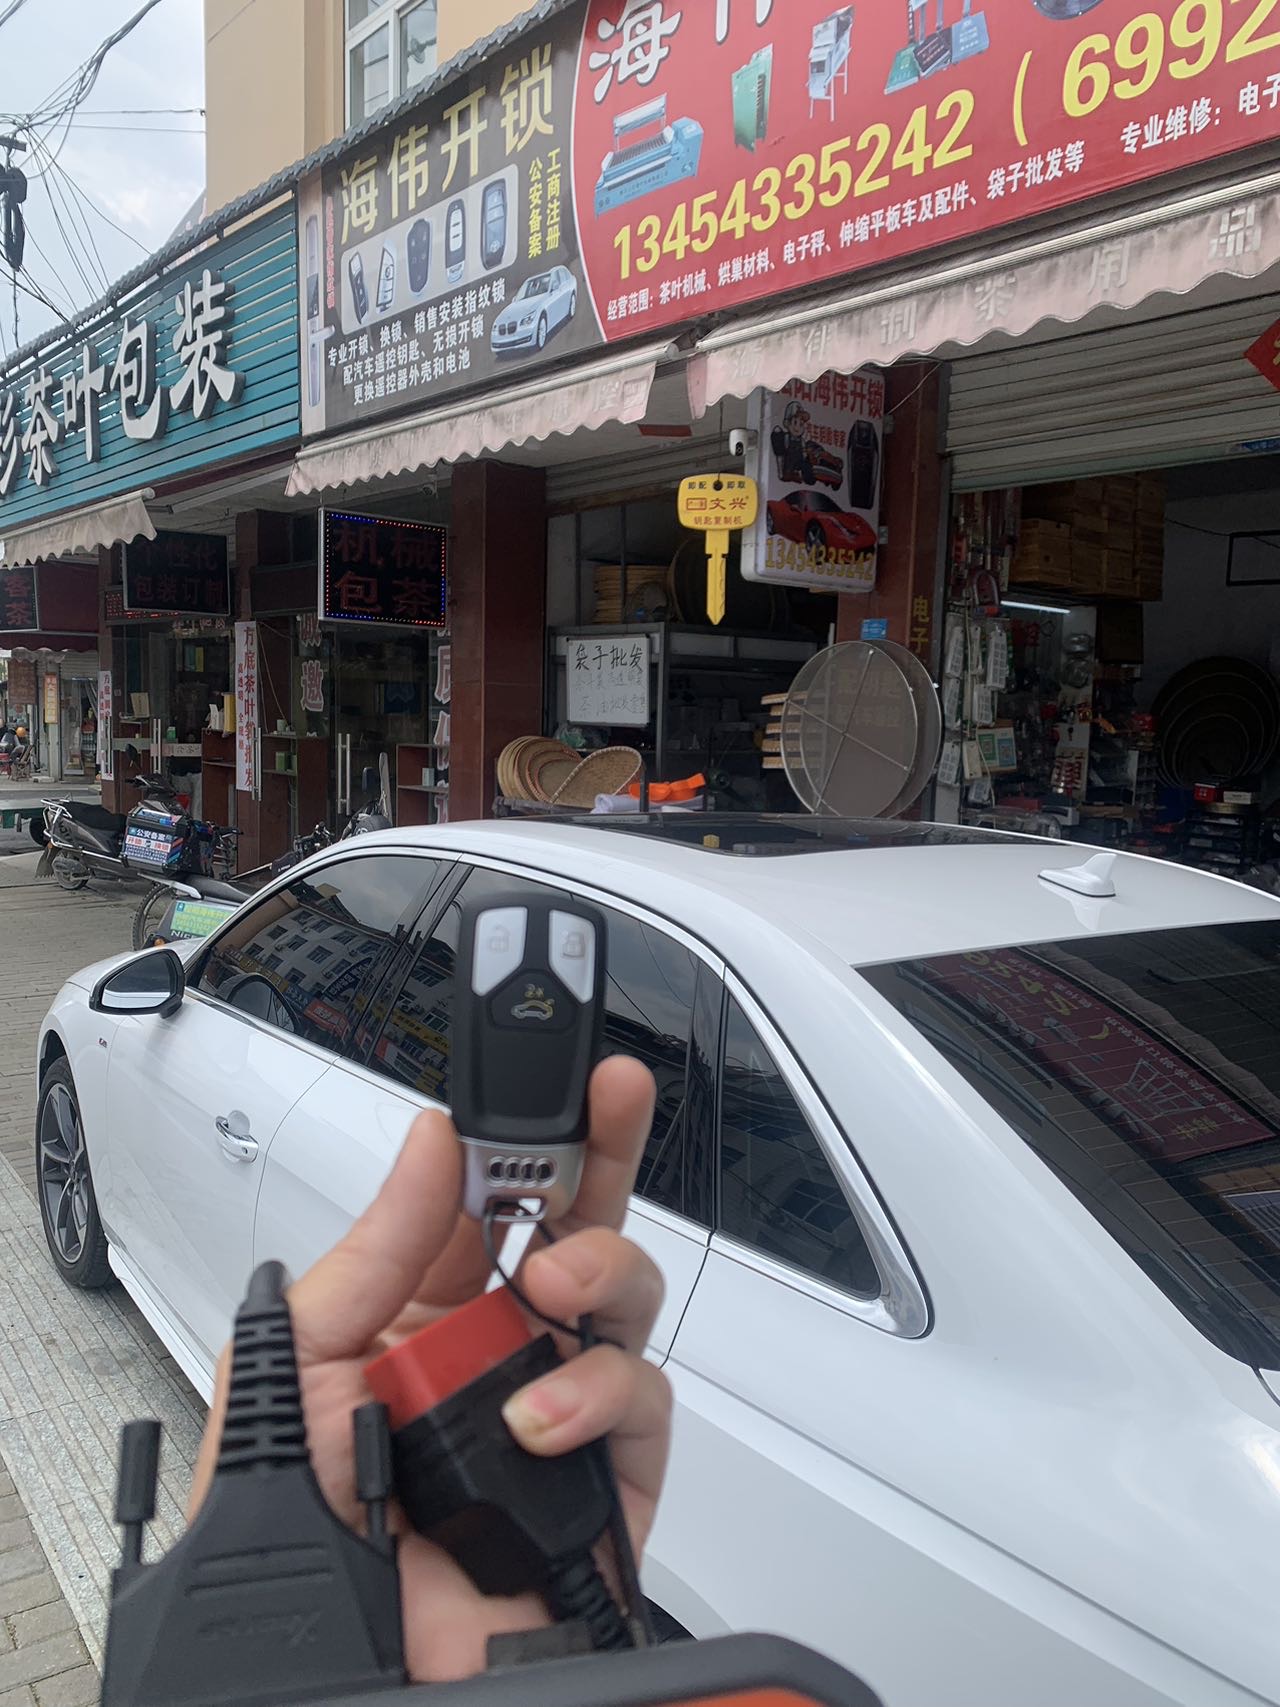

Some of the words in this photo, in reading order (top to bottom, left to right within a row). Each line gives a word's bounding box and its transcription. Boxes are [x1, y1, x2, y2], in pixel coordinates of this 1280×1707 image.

[588, 0, 773, 104] 海
[341, 43, 554, 246] 海伟开锁
[613, 88, 975, 280] 13454335242
[528, 156, 543, 259] 公安备案
[546, 147, 561, 251] 工商注册
[353, 347, 471, 406] 更换遥控器外壳和电池
[765, 537, 874, 581] 13454335242
[575, 643, 643, 672] 袋子批发
